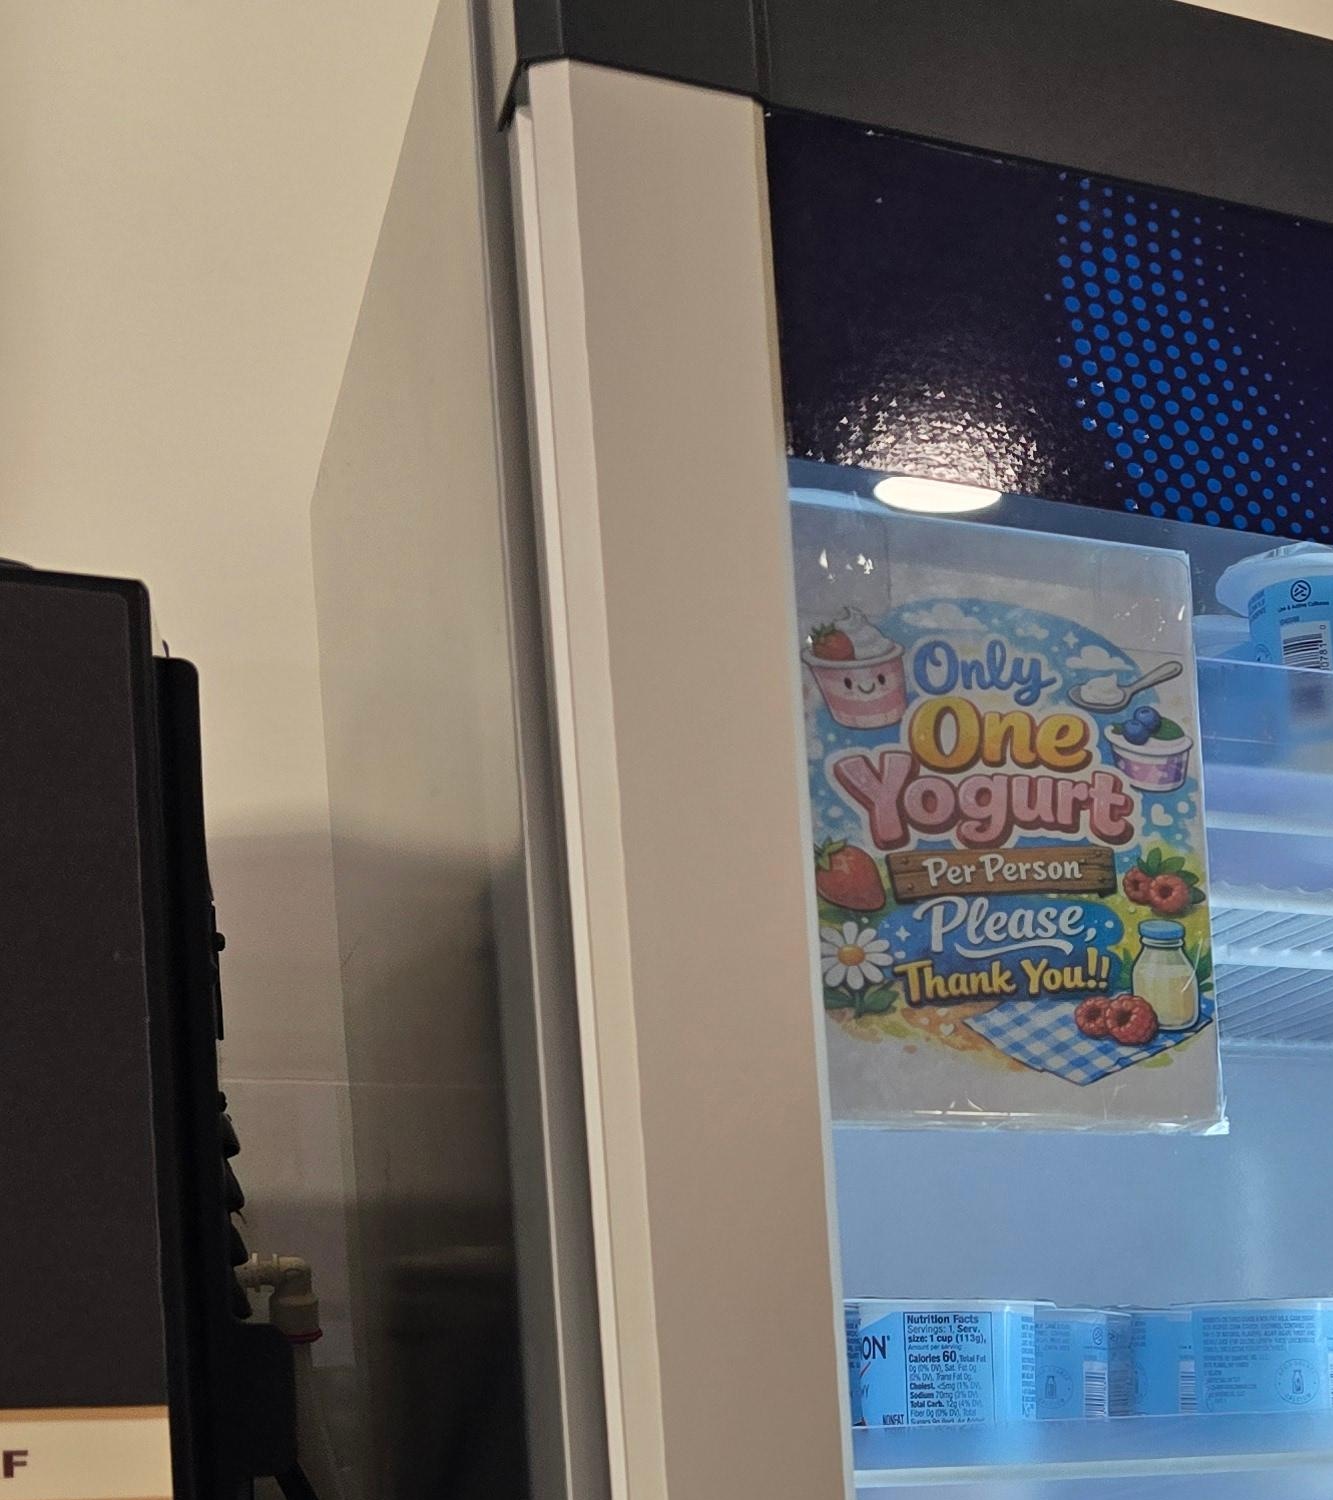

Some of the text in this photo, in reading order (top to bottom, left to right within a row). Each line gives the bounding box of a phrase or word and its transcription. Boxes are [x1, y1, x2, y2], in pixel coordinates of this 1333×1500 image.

[914, 640, 1057, 706] Only
[908, 696, 1093, 775] One
[834, 751, 1135, 850] Yogurt
[922, 854, 1083, 887] Per Person
[912, 896, 1098, 954] Please,
[893, 947, 1111, 1004] Thank You!!
[907, 1314, 979, 1324] Nutrition Facts
[907, 1325, 946, 1335] Servings:
[957, 1325, 980, 1333] Serv.
[908, 1335, 928, 1343] size:
[936, 1336, 953, 1344] cup
[909, 1354, 941, 1363] Calories
[3, 1450, 28, 1479] F
